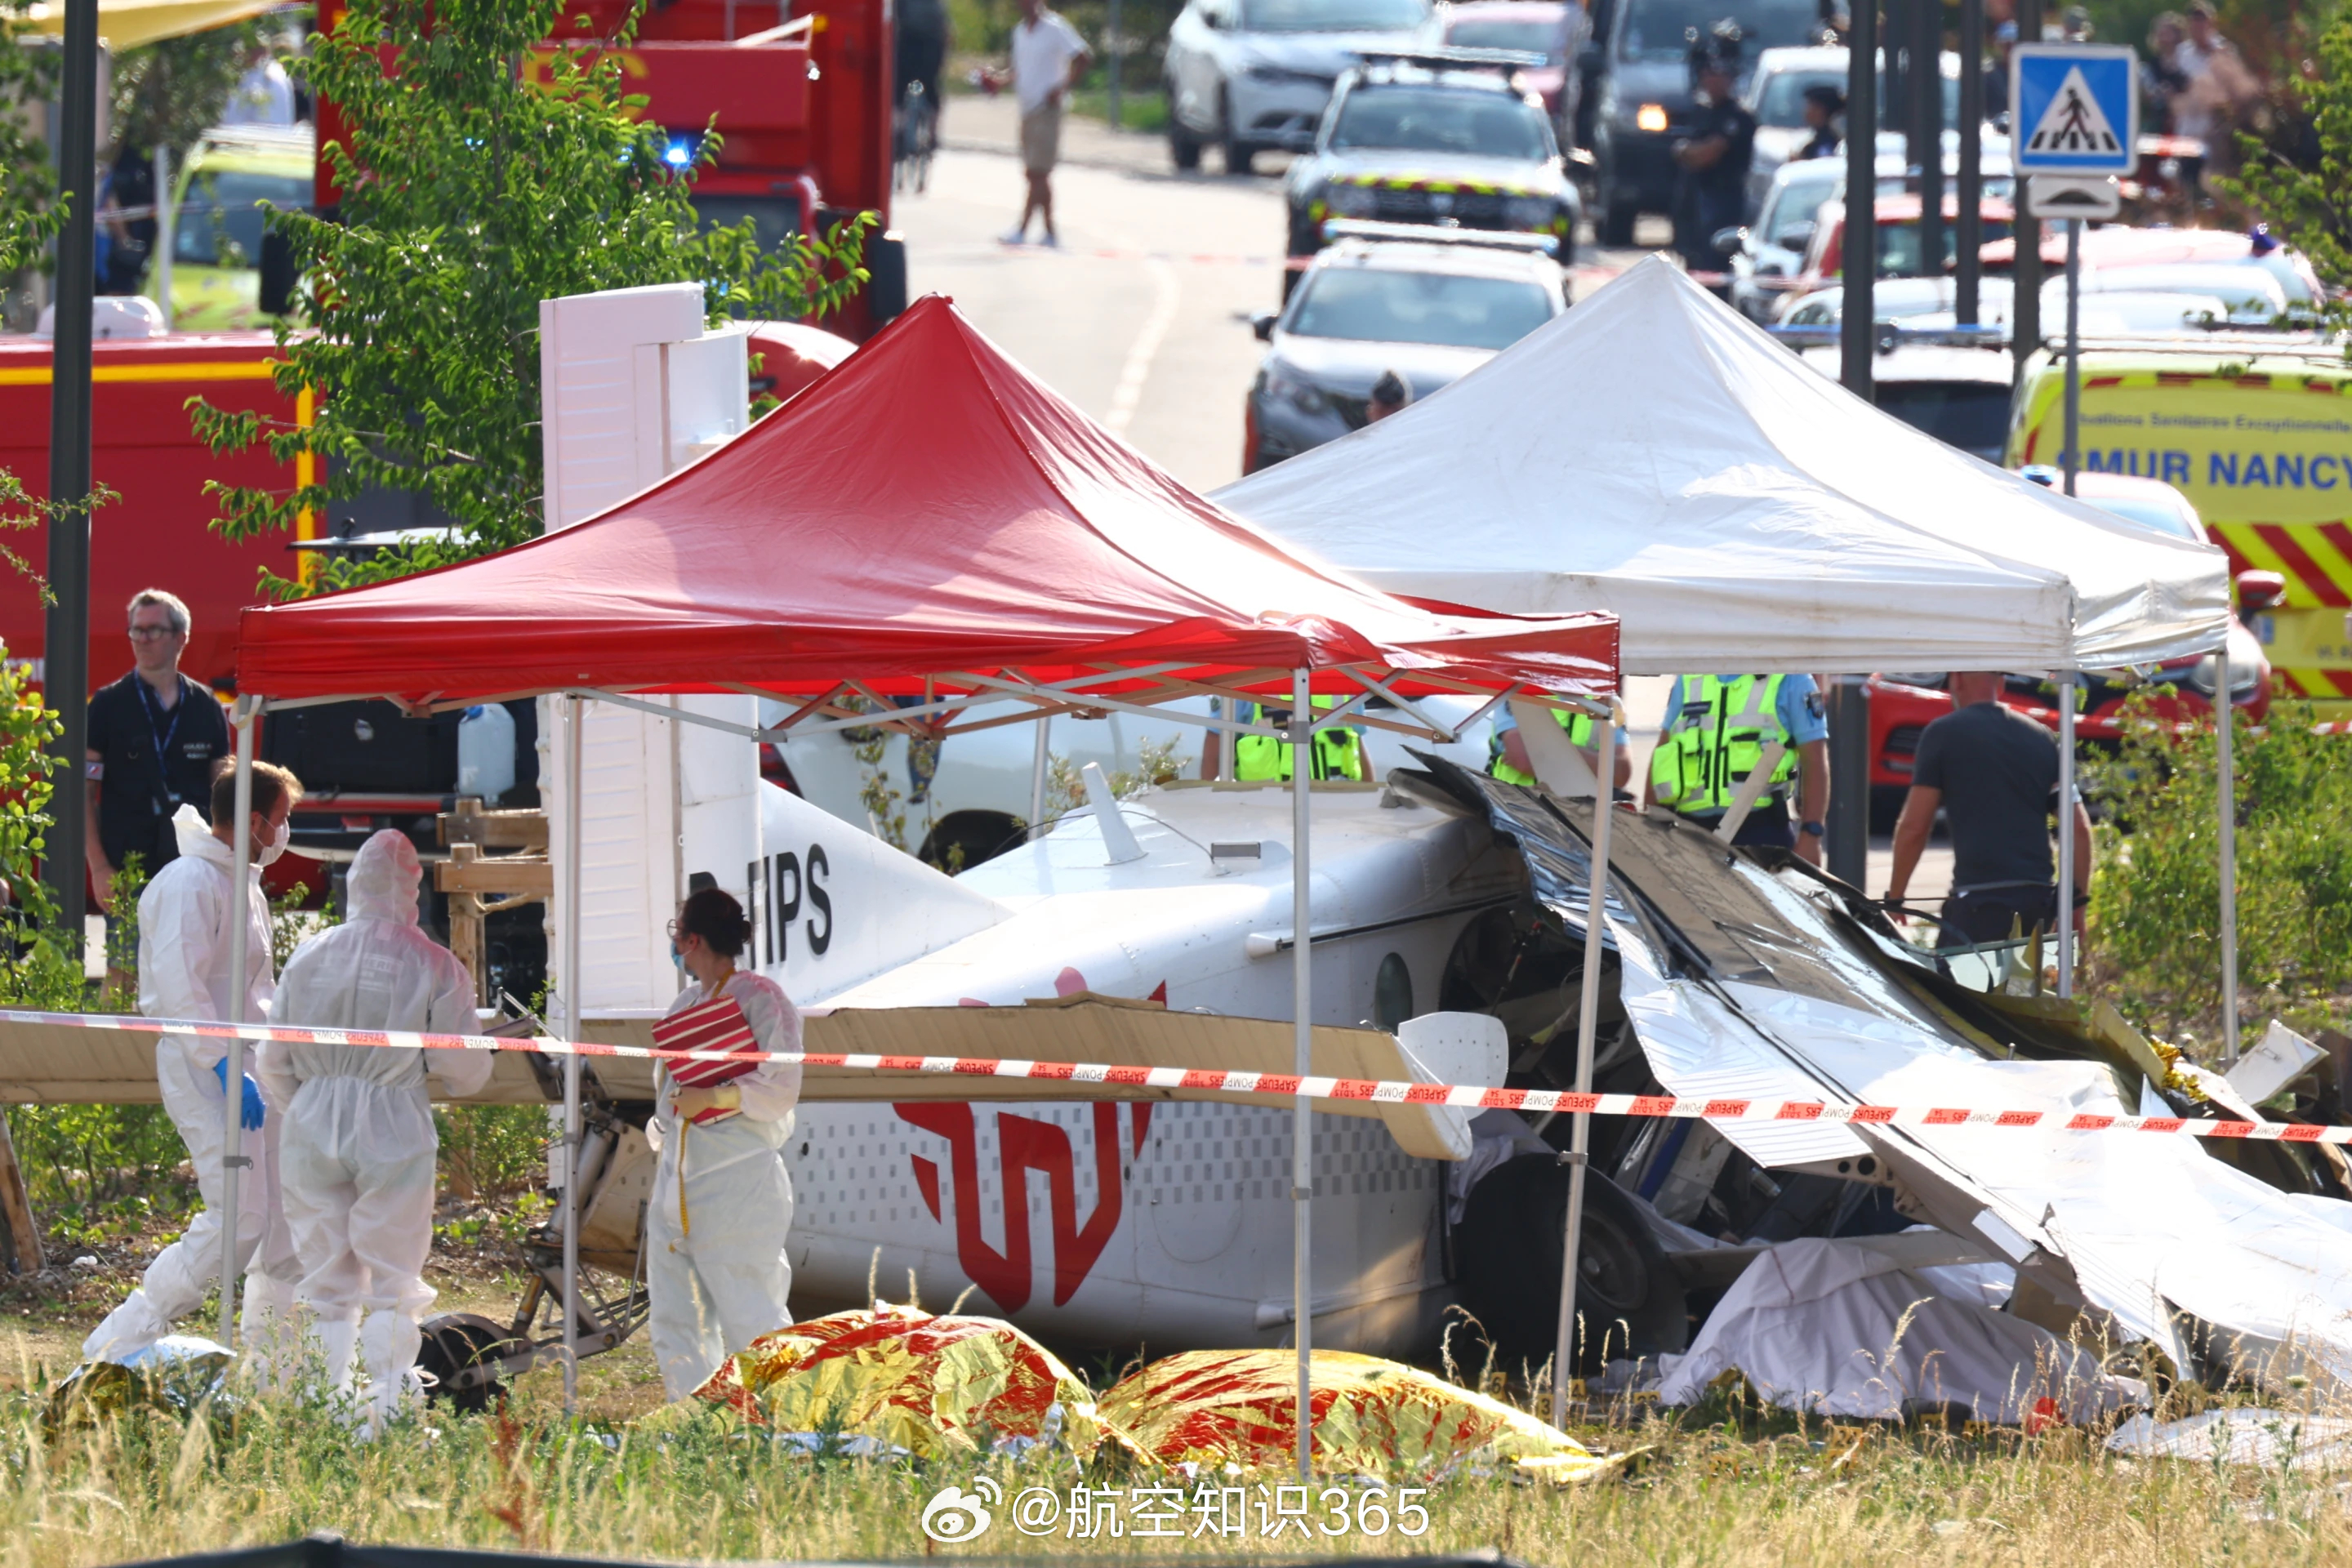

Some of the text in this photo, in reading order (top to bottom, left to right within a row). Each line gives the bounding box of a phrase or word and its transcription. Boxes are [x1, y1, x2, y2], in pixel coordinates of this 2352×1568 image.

[1058, 1067, 1145, 1082] SAPEURS-POMPIERS
[1209, 1076, 1296, 1091] SAPEURS-POMPIERS
[1360, 1085, 1446, 1099] SAPEURS-POMPIERS
[1509, 1094, 1596, 1108] SAPEURS-POMPIERS
[1658, 1102, 1744, 1116] SAPEURS-POMPIERS
[1806, 1107, 1891, 1121] SAPEURS-POMPIERS
[1953, 1112, 2036, 1125] SAPEURS-POMPIERS
[2096, 1119, 2180, 1130] SAPEURS-POMPIERS
[2238, 1126, 2320, 1138] SAPEURS-POMPIERS
[1541, 1397, 1550, 1415] 3
